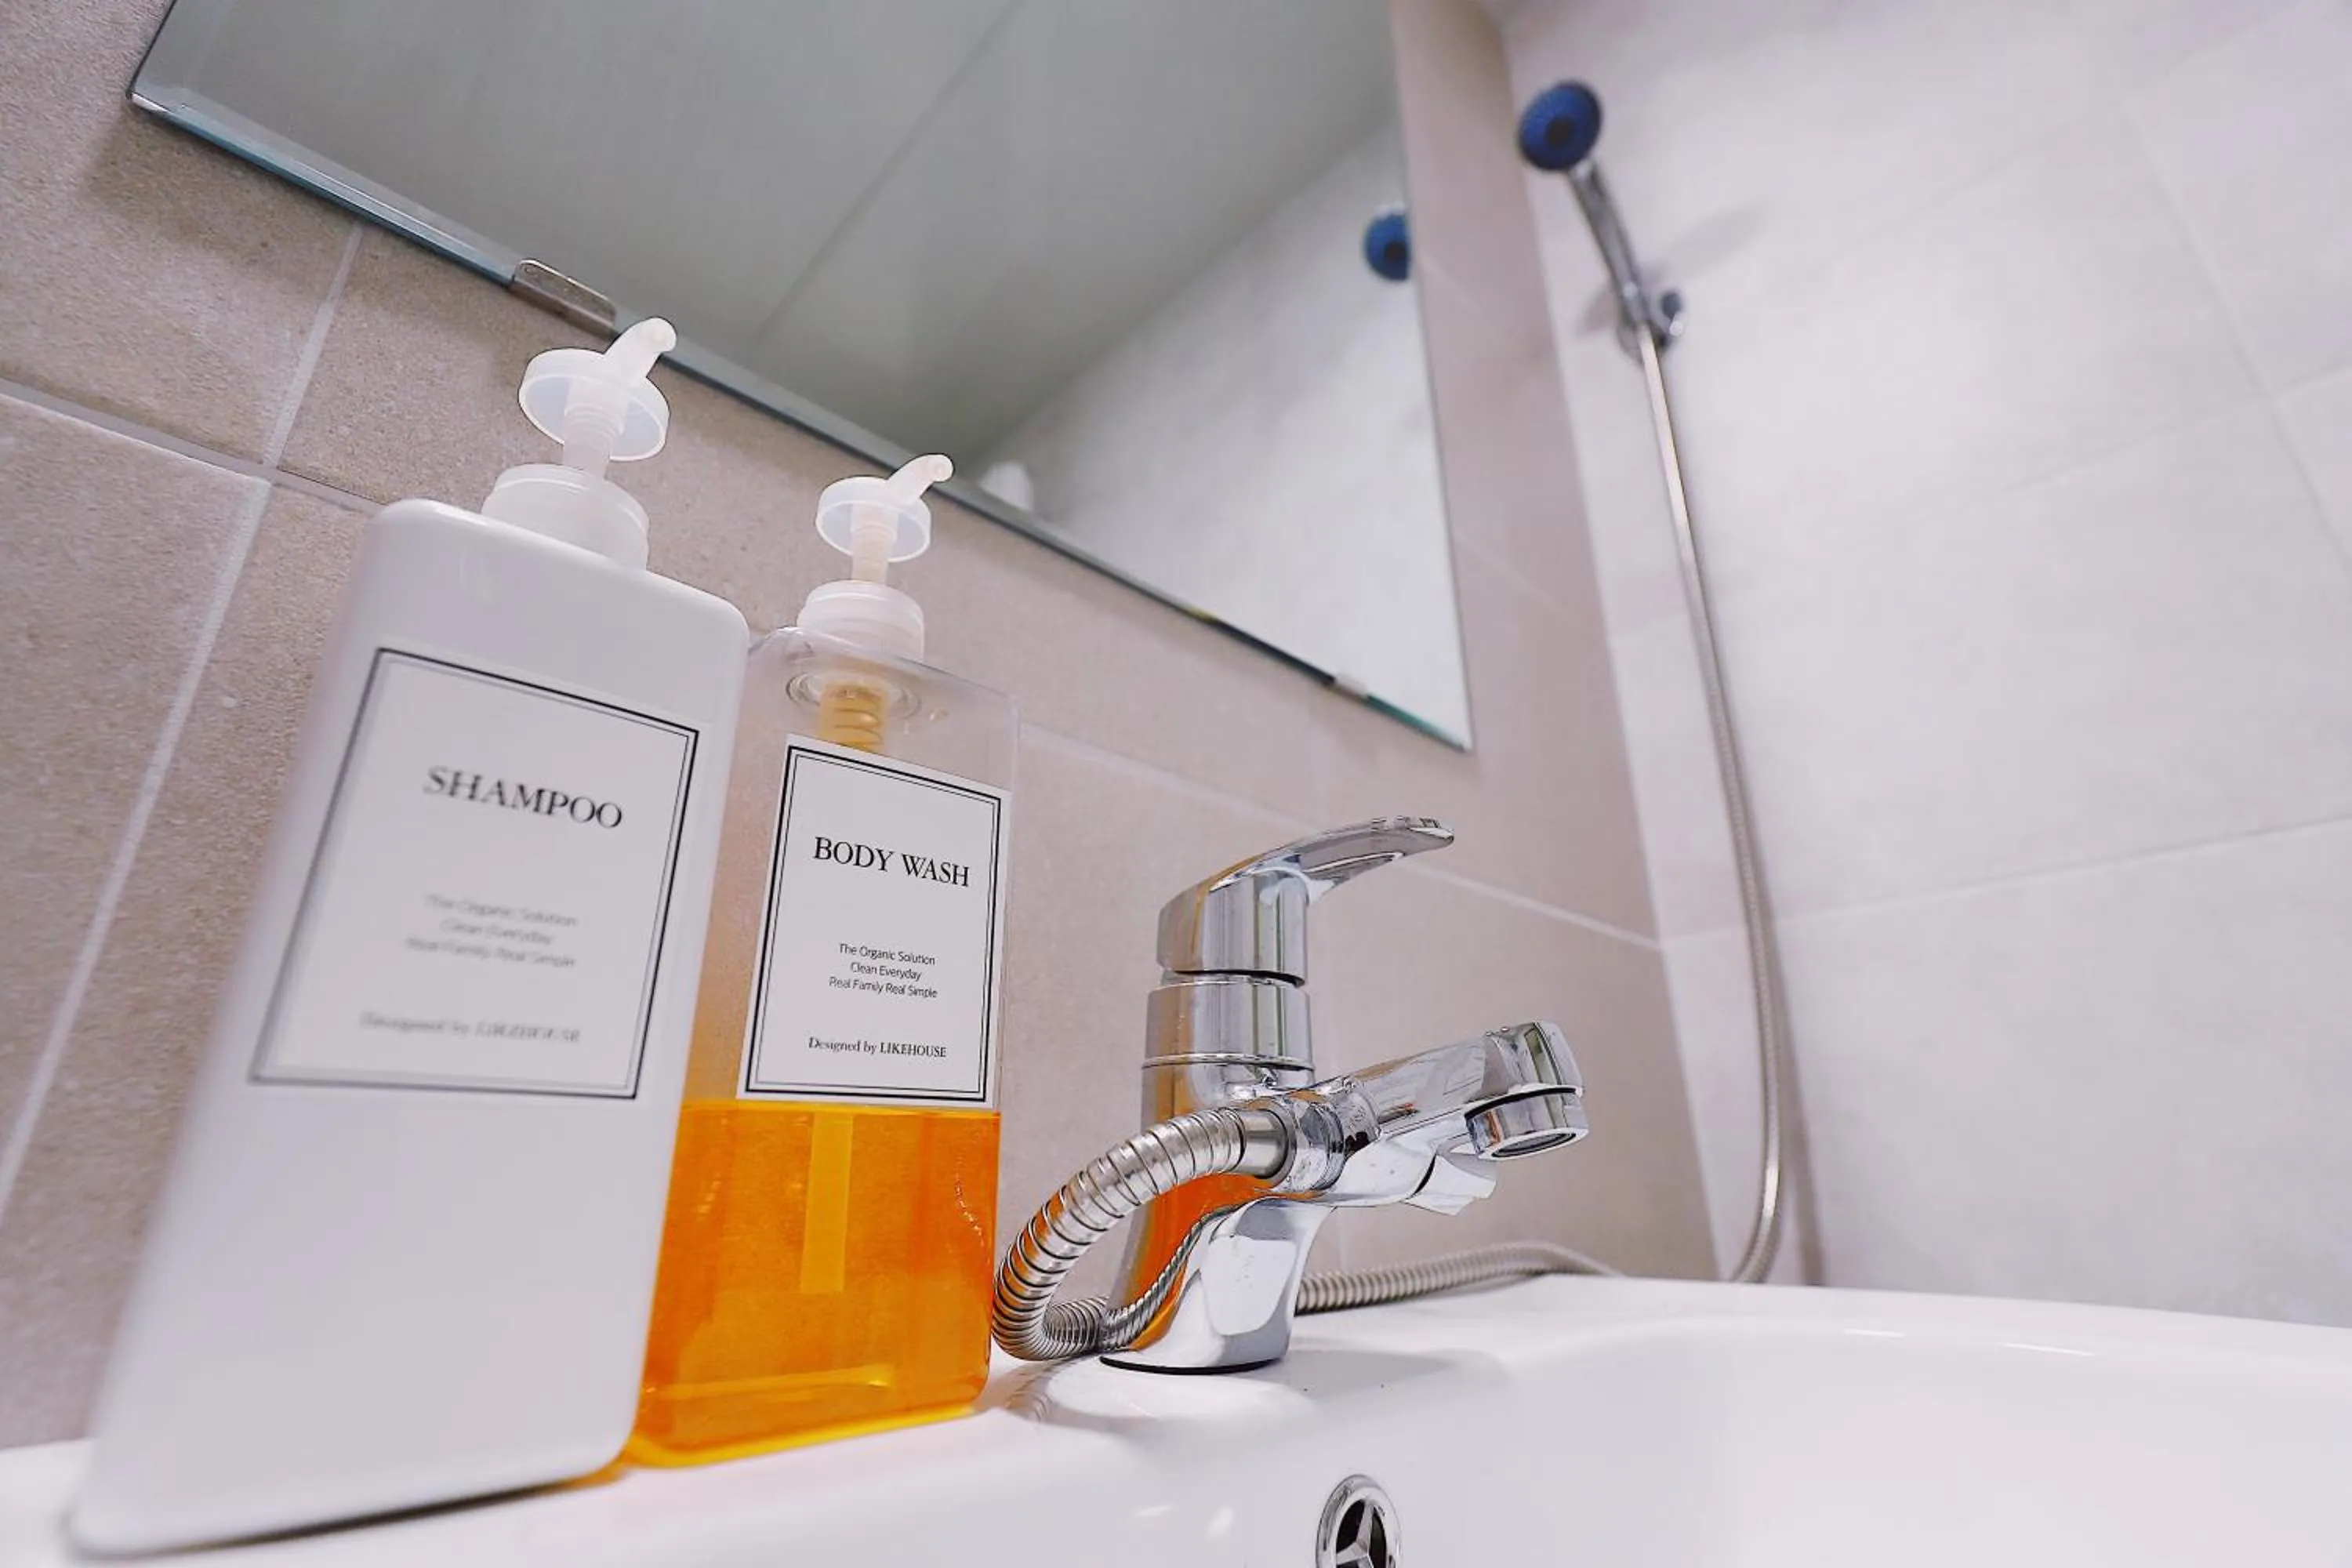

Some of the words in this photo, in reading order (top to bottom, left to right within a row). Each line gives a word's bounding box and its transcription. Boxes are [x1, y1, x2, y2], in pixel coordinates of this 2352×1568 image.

[423, 764, 623, 829] SHAMPOO
[813, 836, 894, 873] BODY
[901, 853, 970, 887] WASH
[840, 943, 857, 955] The
[859, 946, 895, 960] Organic
[898, 951, 935, 965] Solution
[851, 962, 877, 975] Clean
[879, 966, 922, 982] Everyday
[829, 977, 851, 989] Real
[853, 980, 883, 994] Family
[885, 983, 906, 995] Real
[908, 985, 938, 998] Simple
[808, 1036, 861, 1052] Designed
[863, 1041, 877, 1054] by
[880, 1042, 947, 1058] LIKEHOUSE
